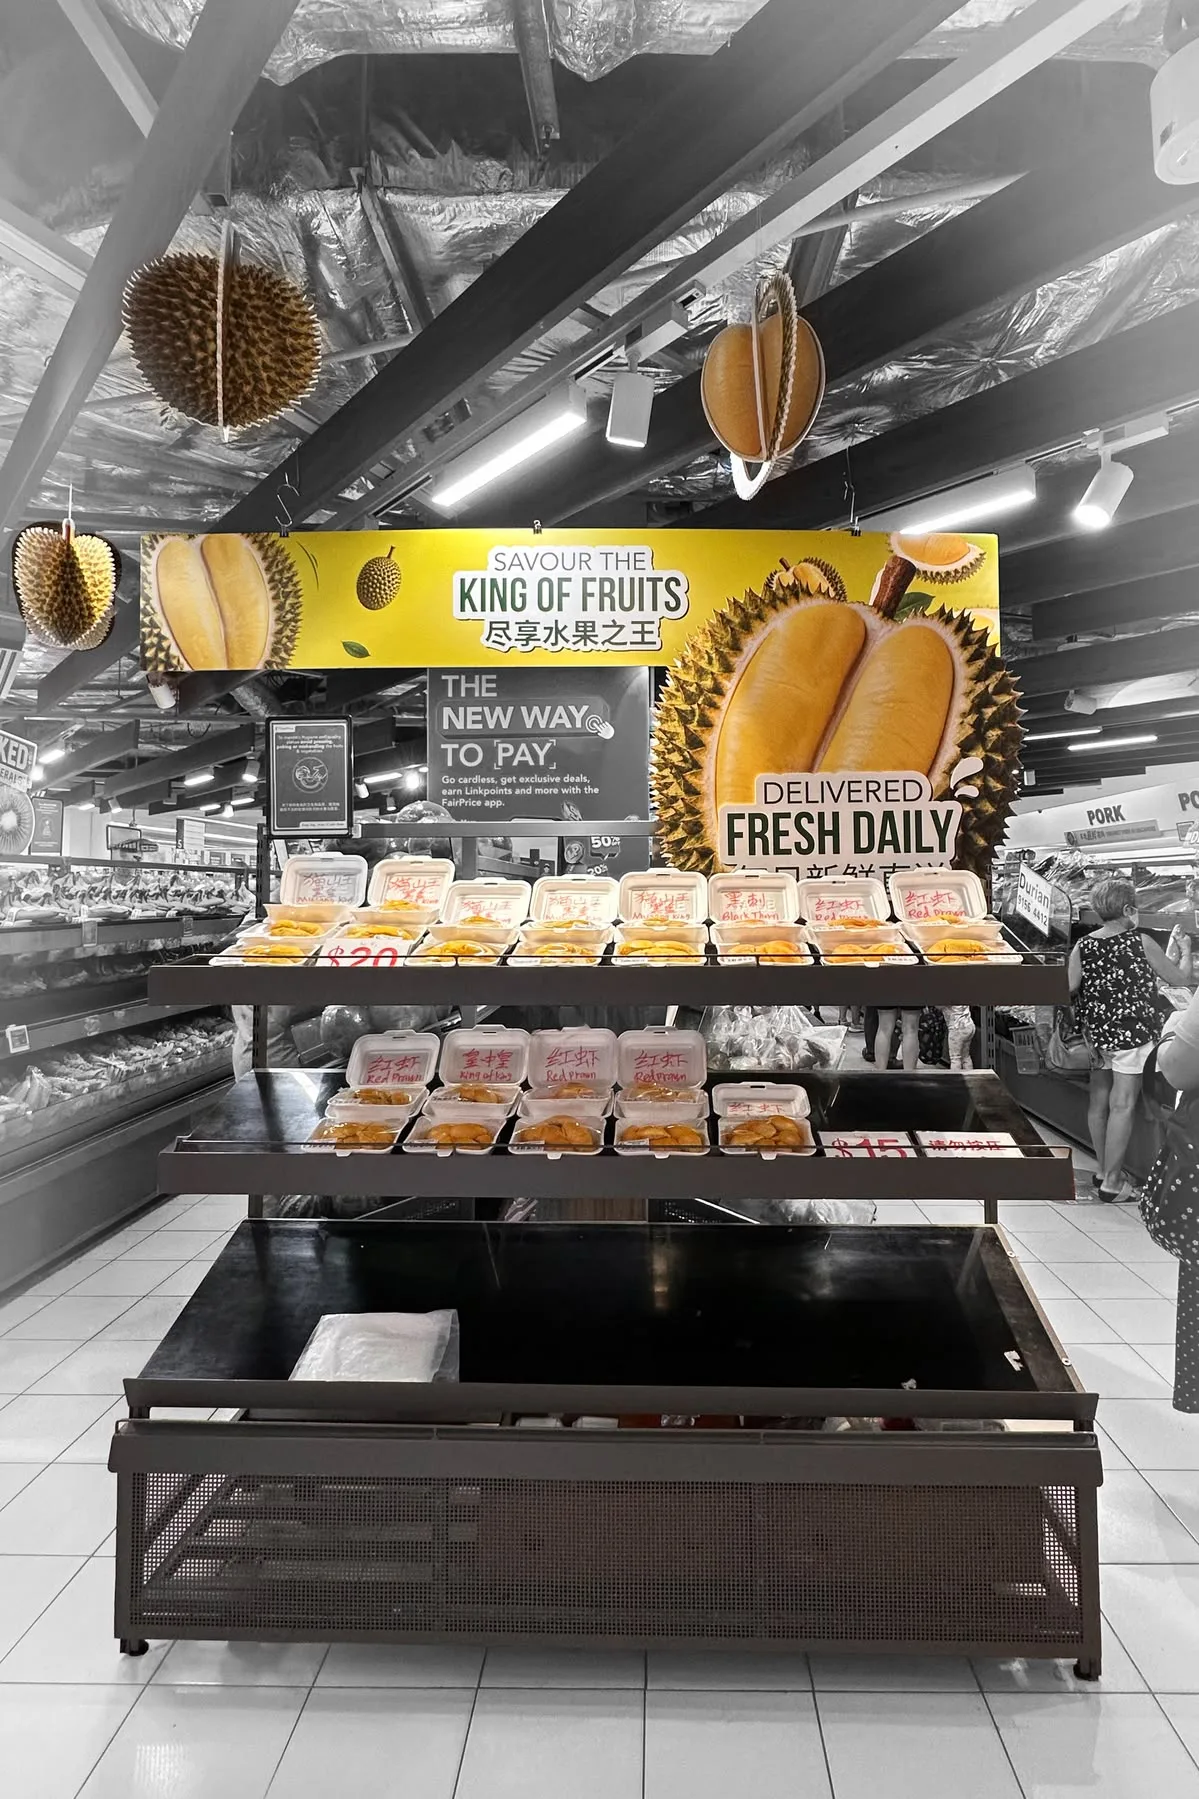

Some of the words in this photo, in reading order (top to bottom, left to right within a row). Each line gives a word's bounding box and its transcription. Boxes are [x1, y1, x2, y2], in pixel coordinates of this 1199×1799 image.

[494, 552, 592, 571] SAVOUR
[600, 552, 646, 571] THE
[460, 577, 527, 612] KING
[537, 577, 572, 612] OF
[582, 576, 681, 612] FRUITS
[485, 619, 657, 646] 尽享水果之王
[441, 675, 498, 697] THE
[442, 706, 514, 730] NEW
[520, 705, 590, 729] WAY
[441, 743, 483, 767] TO
[497, 742, 552, 766] PAY
[441, 776, 456, 784] Go
[458, 775, 498, 785] cardless,
[501, 776, 517, 786] get
[519, 775, 561, 784] exclusive
[563, 774, 591, 784] deals,
[441, 788, 462, 796] earn
[465, 787, 512, 797] Linkpoints
[515, 786, 532, 795] and
[534, 787, 559, 795] more
[561, 786, 581, 795] with
[583, 785, 600, 794] the
[441, 798, 482, 807] FairPrice
[484, 800, 505, 808] app.
[764, 780, 923, 804] DELIVERED
[1087, 805, 1126, 826] PORK
[727, 811, 840, 856] FRESH
[853, 809, 954, 854] DAILY
[1020, 872, 1049, 909] Durian
[327, 945, 399, 967] $20
[547, 1068, 567, 1081] Red
